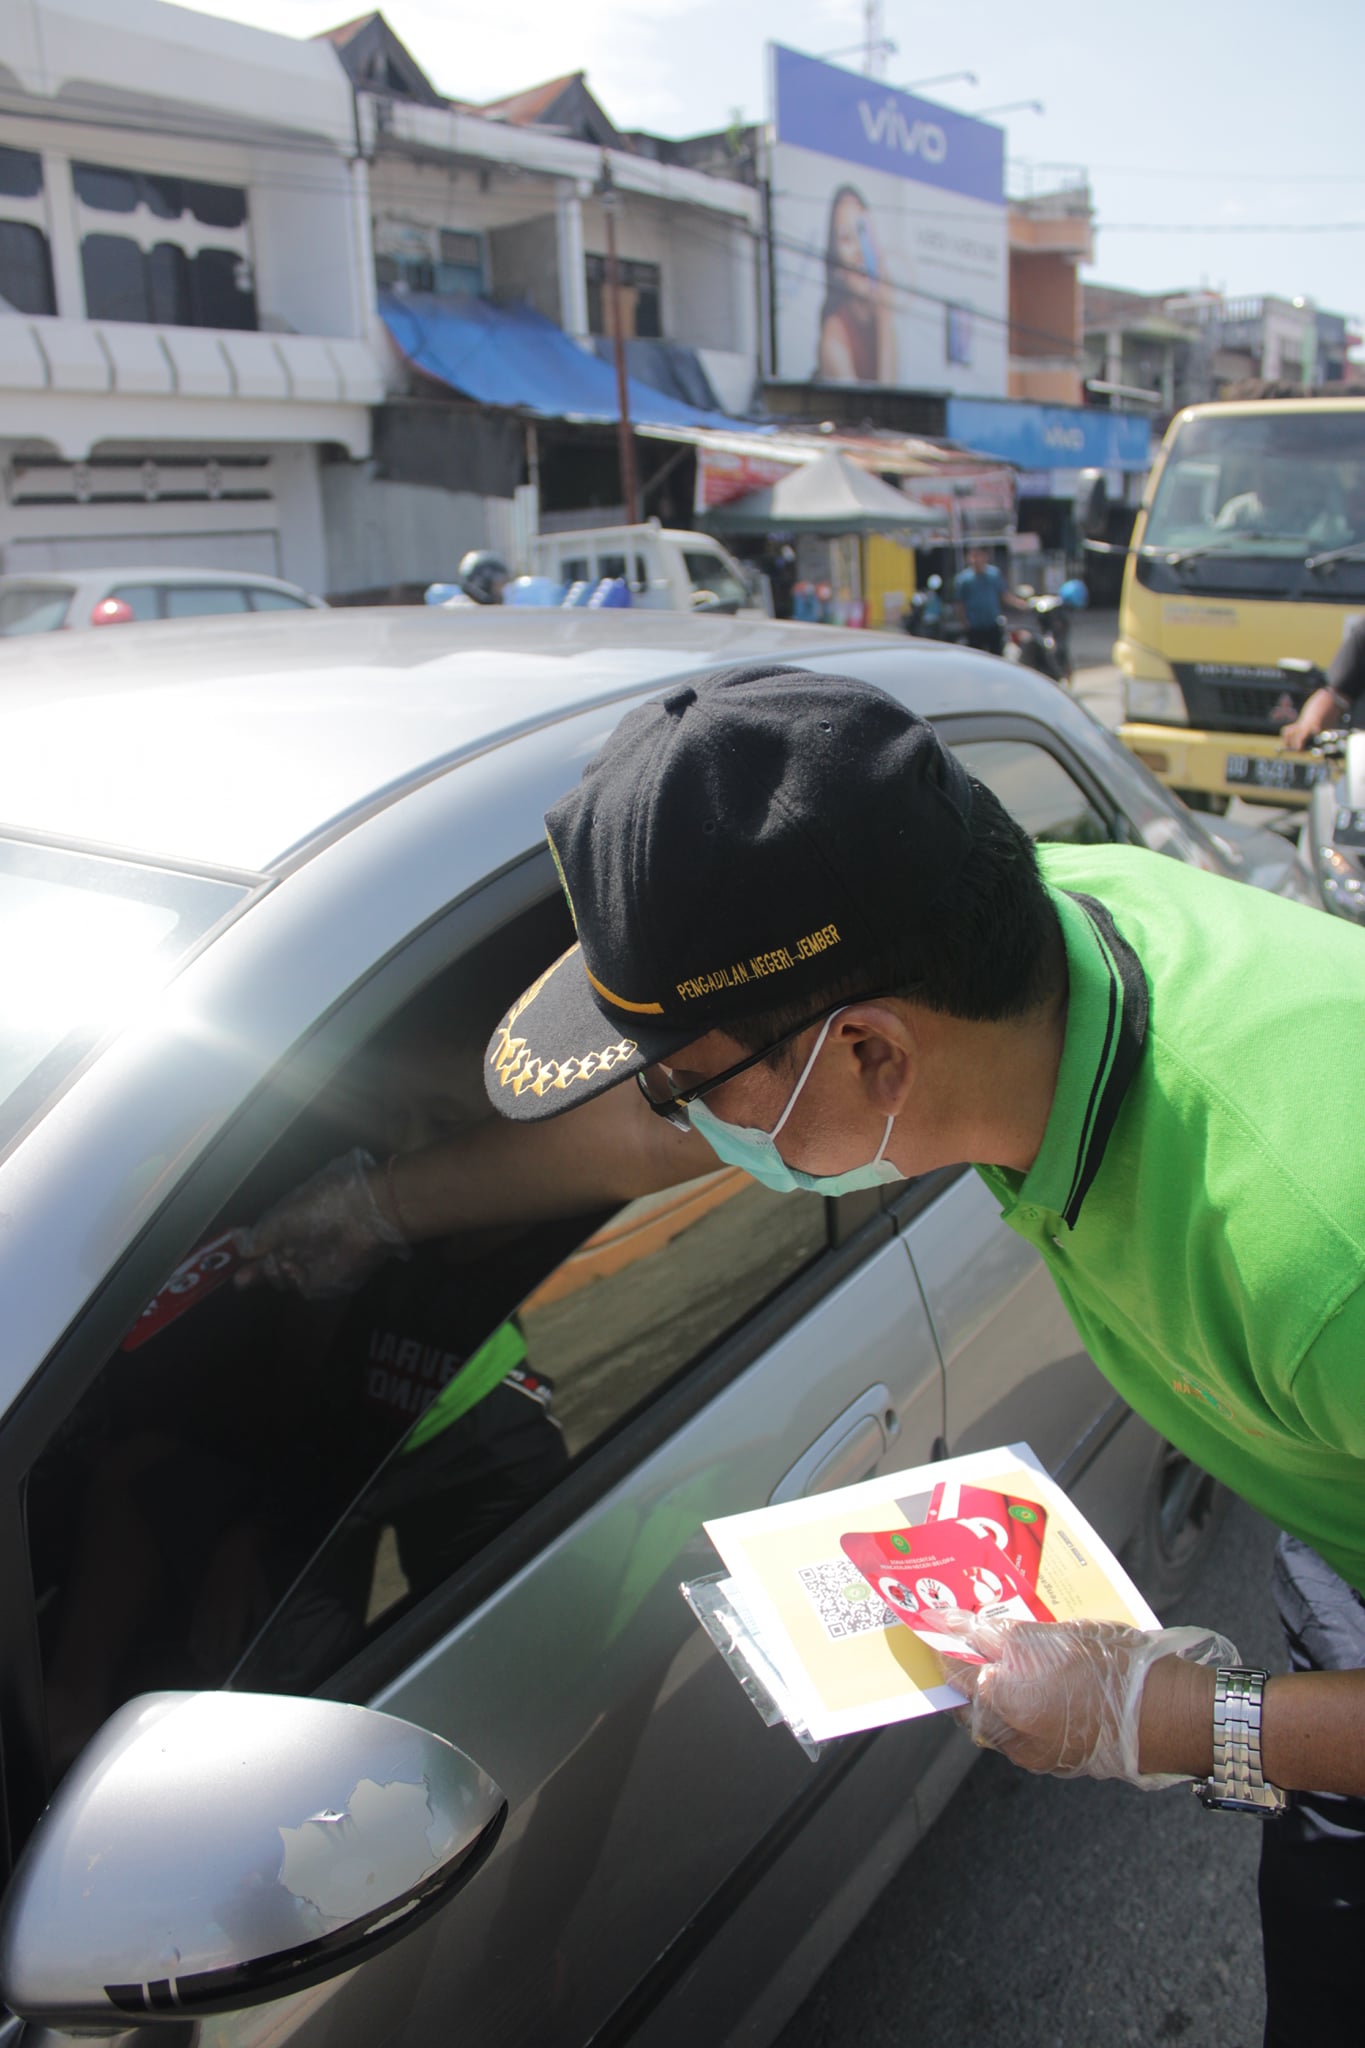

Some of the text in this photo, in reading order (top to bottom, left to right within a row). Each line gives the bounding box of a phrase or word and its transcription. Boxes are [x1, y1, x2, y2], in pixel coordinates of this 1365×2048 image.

[857, 96, 947, 164] vivo
[676, 923, 841, 1001] PENGADILAN NEGERI JEMBER
